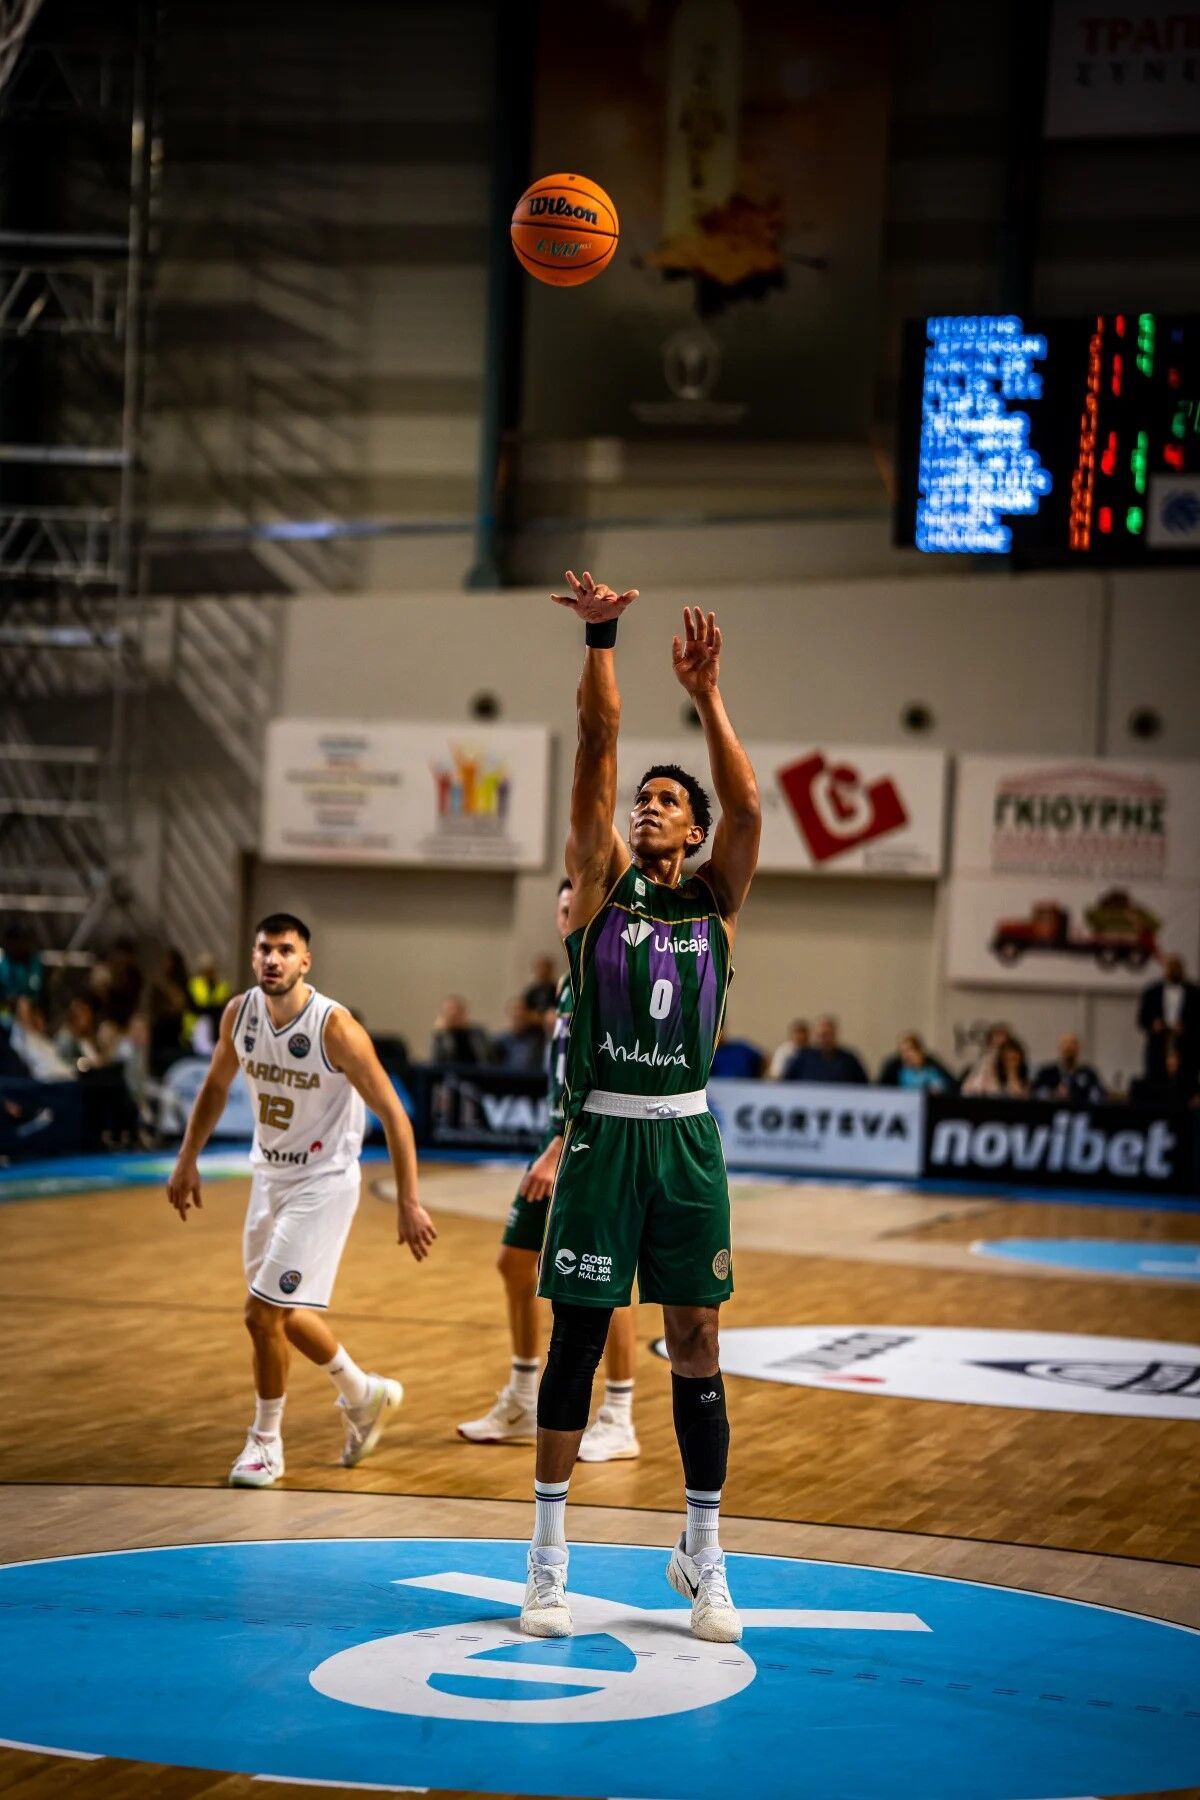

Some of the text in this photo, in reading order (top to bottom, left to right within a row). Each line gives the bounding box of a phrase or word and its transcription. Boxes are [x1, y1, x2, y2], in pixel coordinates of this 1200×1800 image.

[528, 196, 598, 226] Wilson
[994, 793, 1166, 835] ΓΚΙΟΥΡΗΣ
[655, 935, 708, 956] Unicaja
[649, 978, 674, 1020] 0
[242, 1058, 320, 1090] ARDITSA
[258, 1093, 295, 1131] 12
[735, 1104, 908, 1140] CORTEVA
[930, 1110, 1177, 1179] novibet
[580, 1263, 611, 1274] DEL SOL
[582, 1253, 612, 1266] COSTA
[578, 1271, 611, 1282] MÁLAGA
